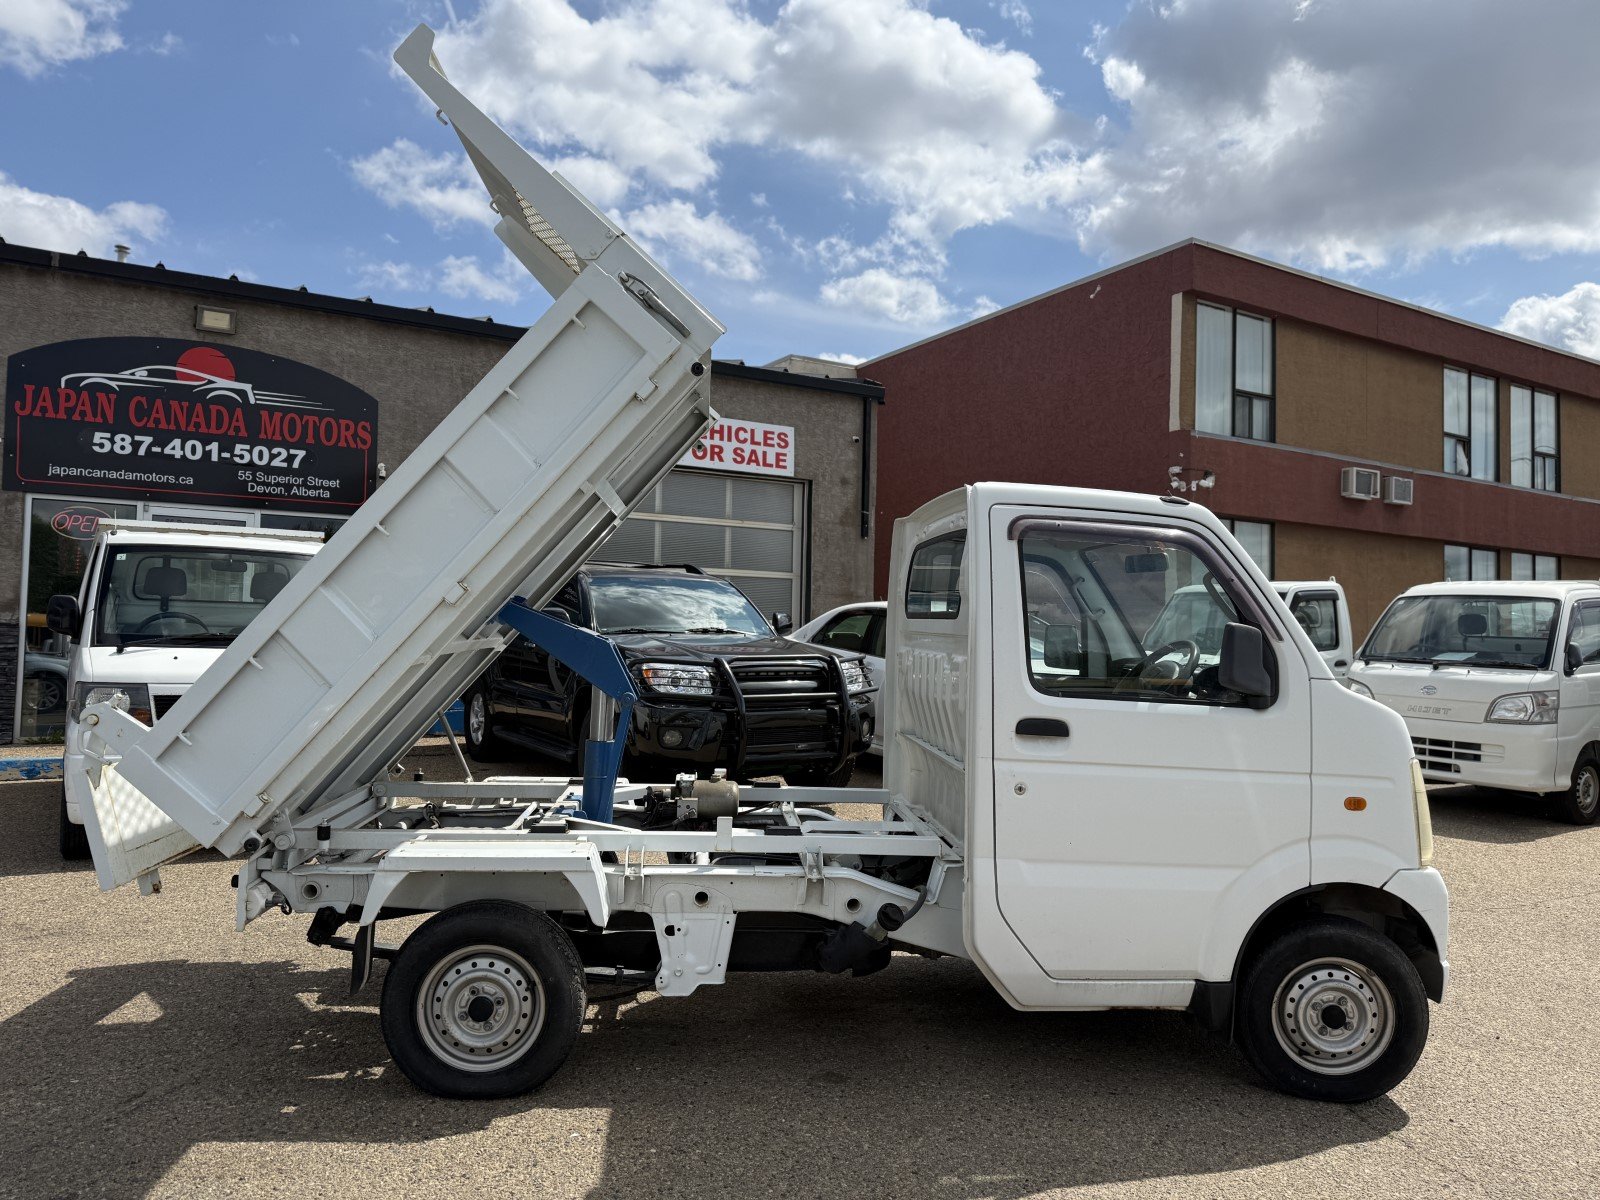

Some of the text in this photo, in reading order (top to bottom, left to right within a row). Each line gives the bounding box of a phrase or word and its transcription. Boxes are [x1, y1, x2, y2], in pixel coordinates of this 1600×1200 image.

[14, 384, 373, 450] JAPAN CANADA MOTORS
[92, 431, 307, 469] 587-401-5027
[691, 444, 787, 469] OR SALE
[47, 463, 194, 485] japancanadamotors.ca
[237, 470, 340, 488] 55 Superior Street
[247, 482, 330, 498] Devon, Alberta
[1407, 704, 1452, 715] HIJET
